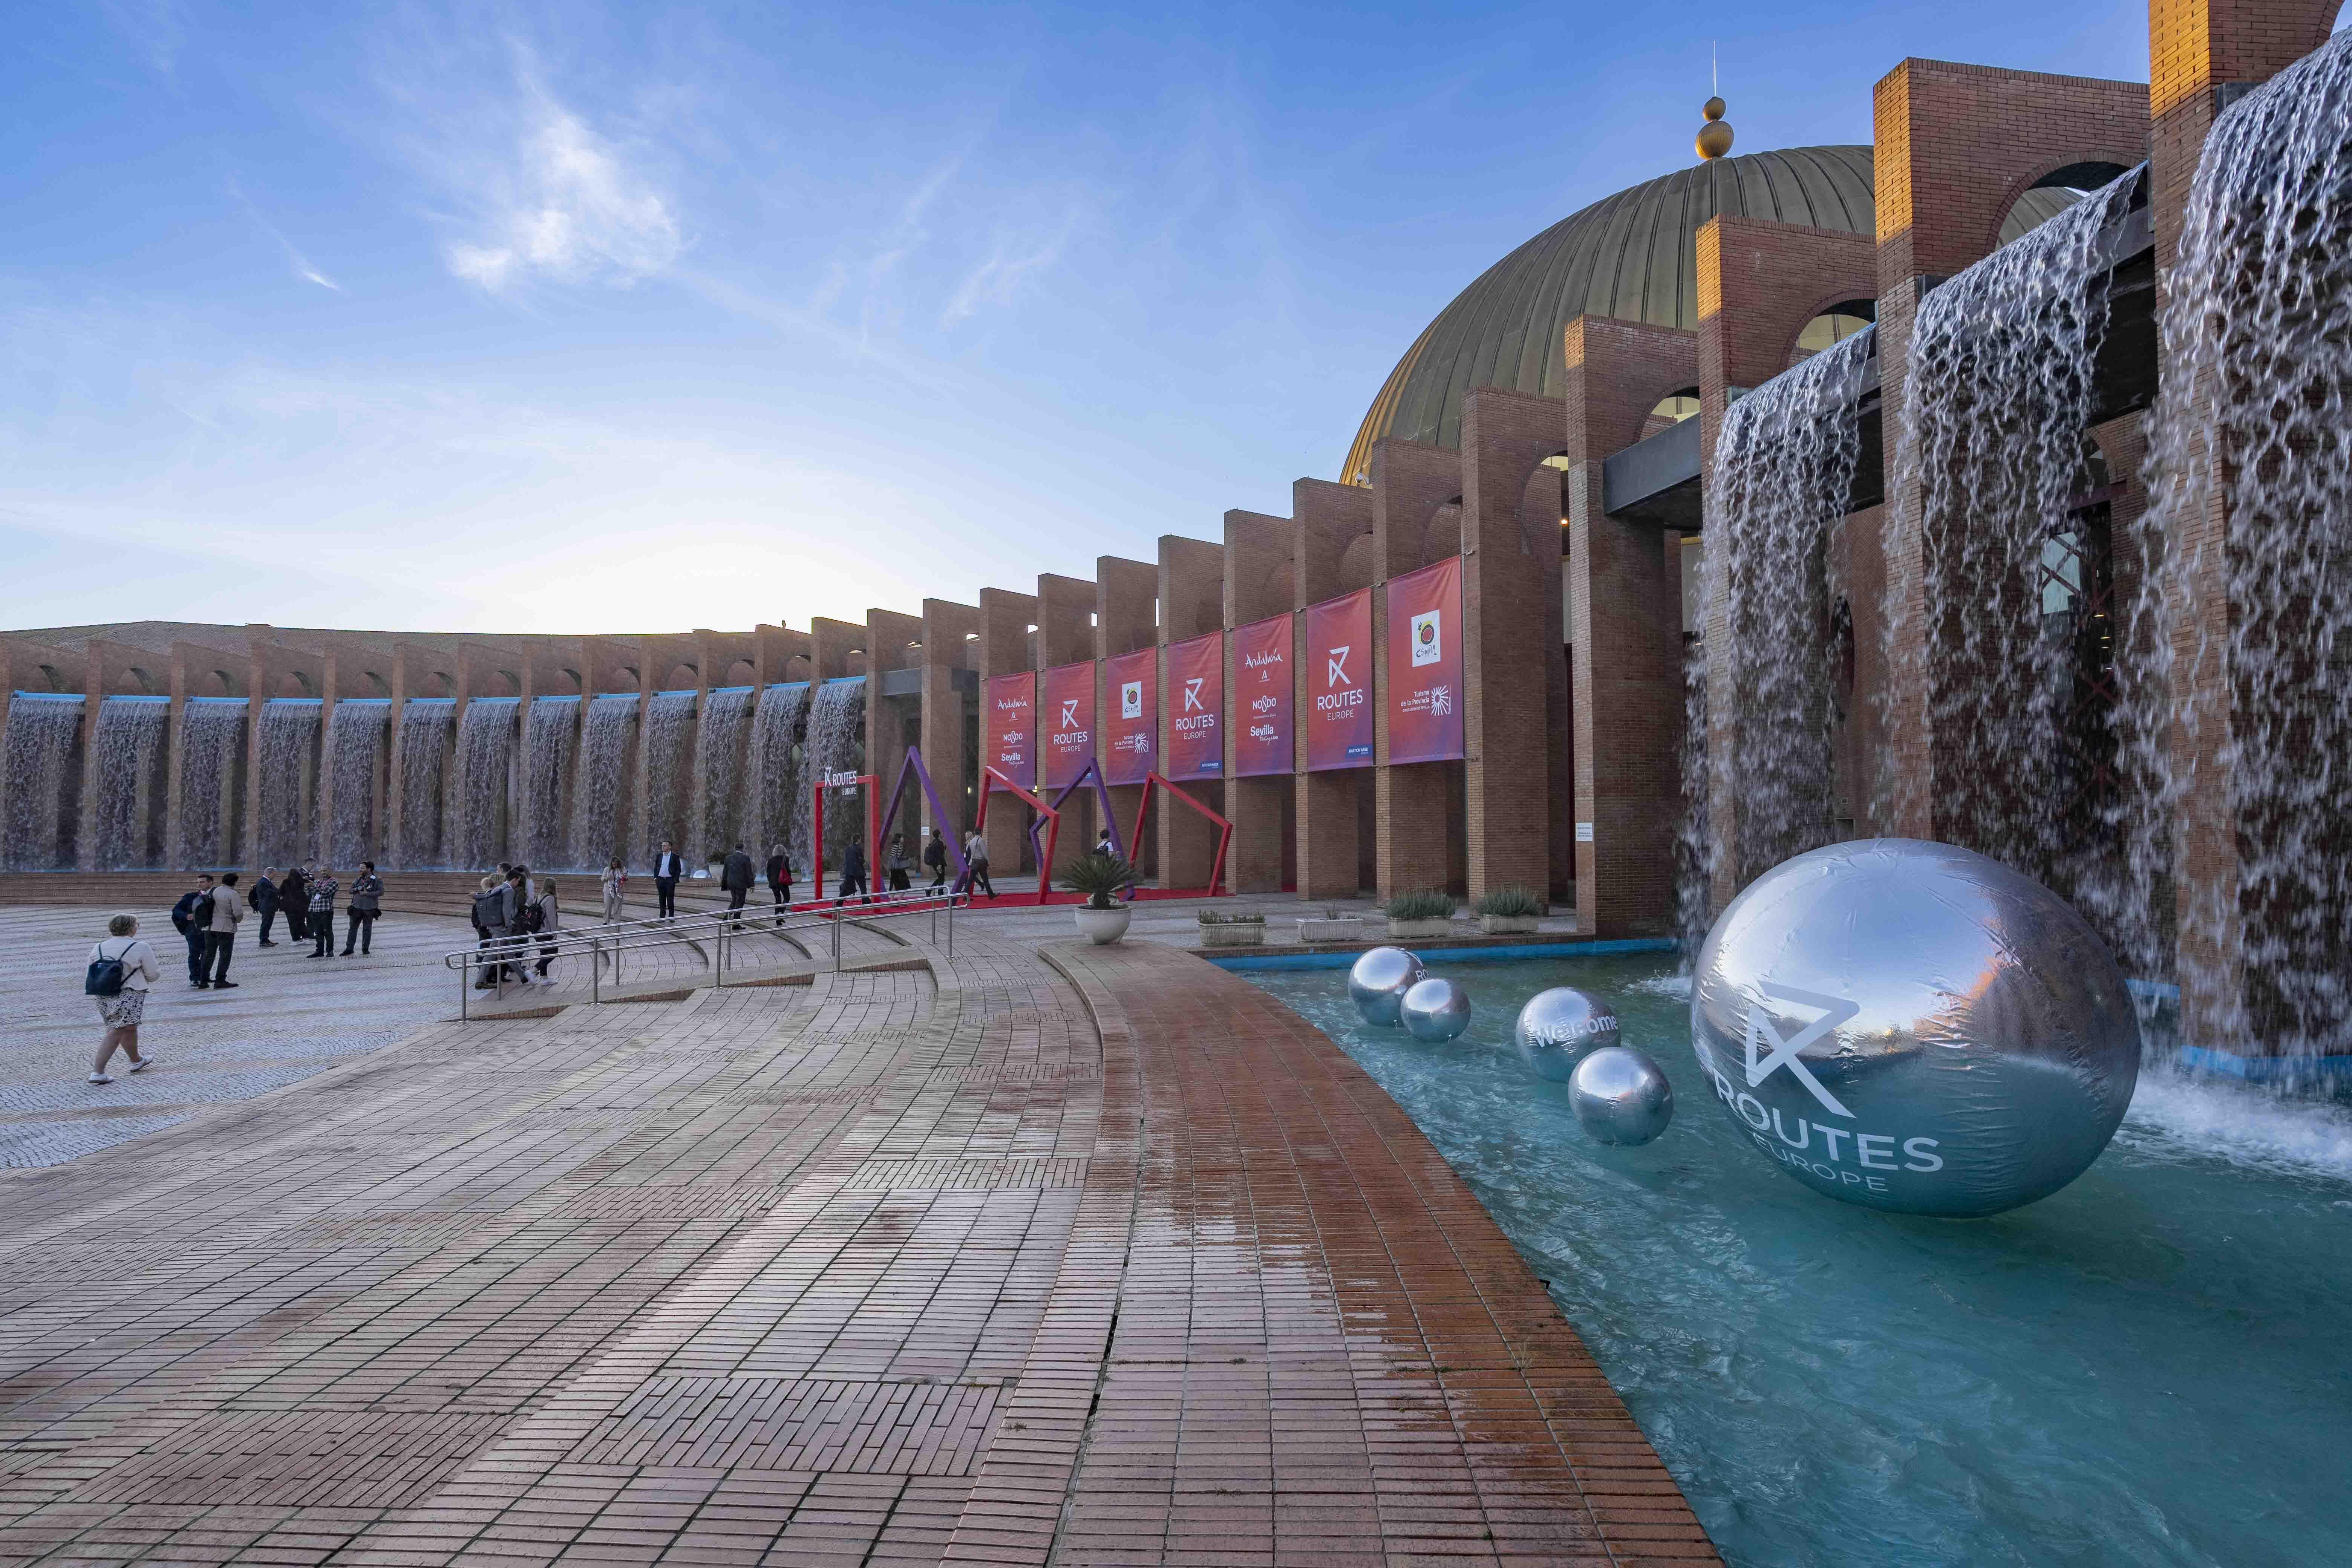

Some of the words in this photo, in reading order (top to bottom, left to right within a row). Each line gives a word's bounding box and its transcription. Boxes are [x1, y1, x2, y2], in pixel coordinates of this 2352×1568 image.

[1245, 648, 1283, 669] Andalucía
[997, 697, 1029, 710] Andalucía
[1317, 689, 1363, 710] ROUTES
[1412, 697, 1430, 705] Provincia
[1176, 714, 1214, 730] ROUTES
[1327, 709, 1354, 721] EUROPE
[1184, 730, 1206, 740] EUROPE
[1250, 724, 1274, 737] Sevilla
[1054, 731, 1087, 745] ROUTES
[1001, 752, 1021, 761] Sevilla
[833, 770, 857, 787] ROUTES
[842, 787, 857, 795] EUROPE
[1534, 1015, 1619, 1047] Welcome
[1712, 1068, 1943, 1172] ROUTES
[1752, 1130, 1888, 1191] EUROPE
